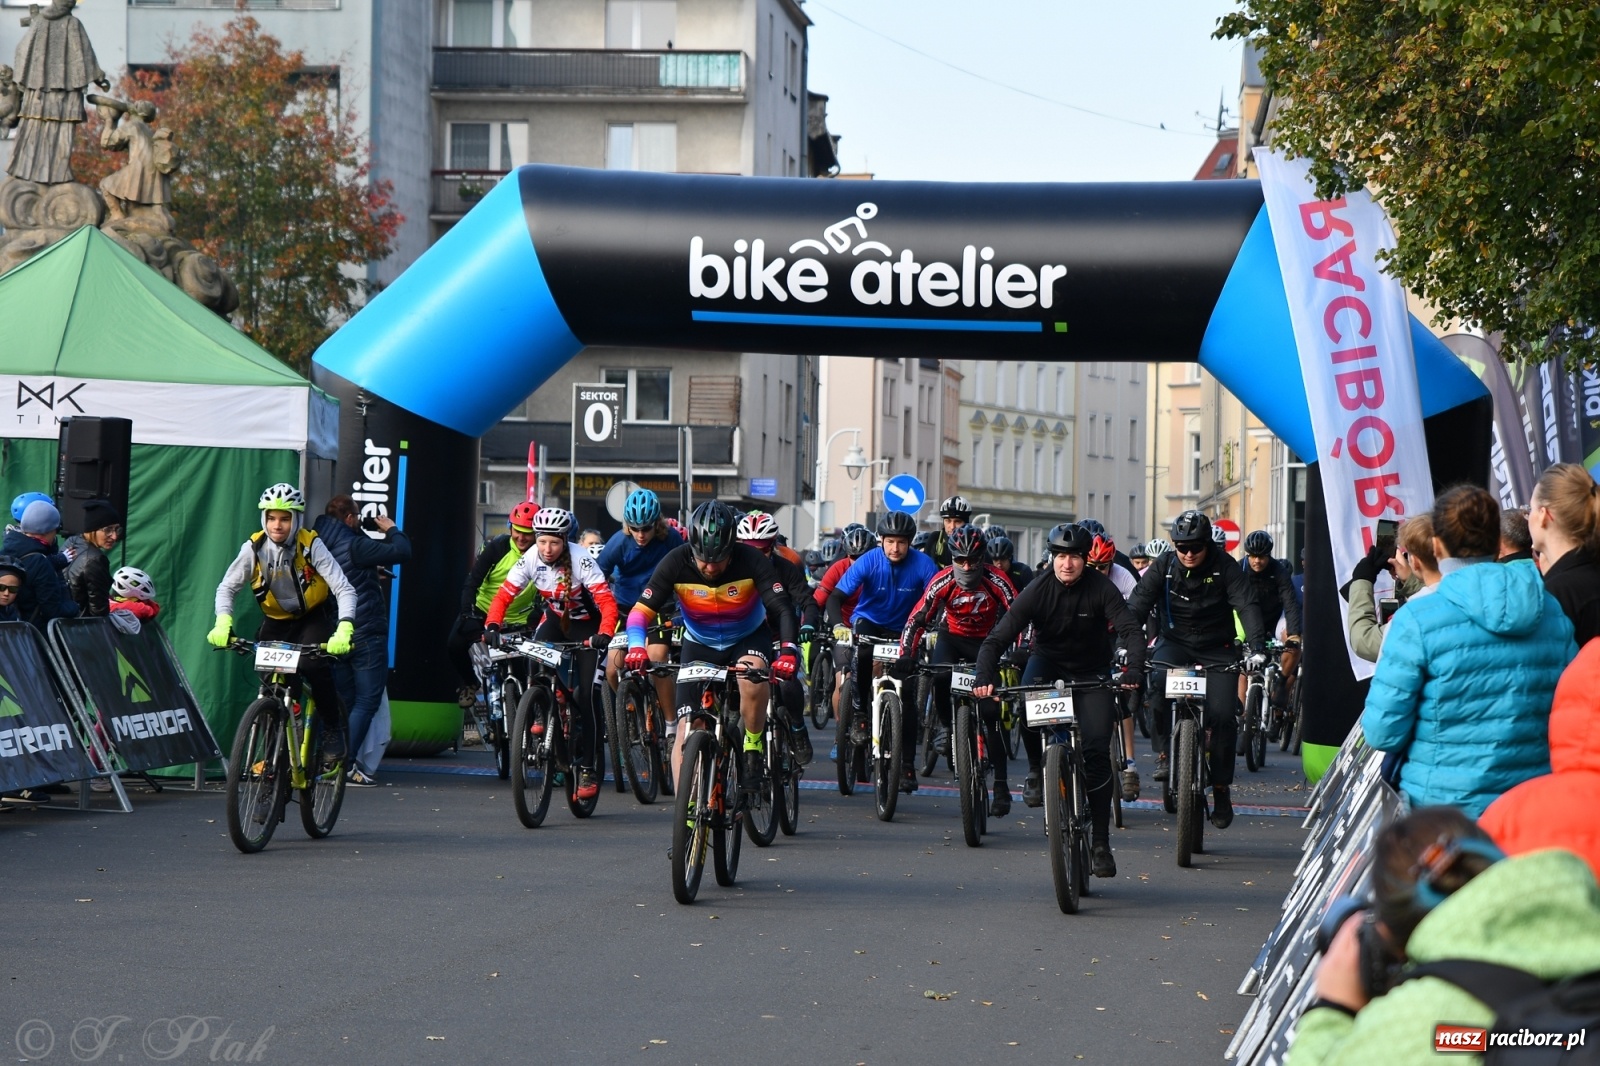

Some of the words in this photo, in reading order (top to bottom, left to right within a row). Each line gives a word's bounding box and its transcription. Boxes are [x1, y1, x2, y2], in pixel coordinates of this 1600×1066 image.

[689, 236, 829, 303] bike
[850, 244, 1067, 309] atelier
[580, 391, 618, 401] SEKTOR
[584, 402, 613, 442] 0
[263, 650, 292, 662] 2479
[777, 660, 795, 670] FOX
[687, 668, 720, 676] 1973
[1172, 681, 1199, 691] 2151
[1034, 702, 1066, 715] 2692
[111, 708, 193, 742] MERIDA
